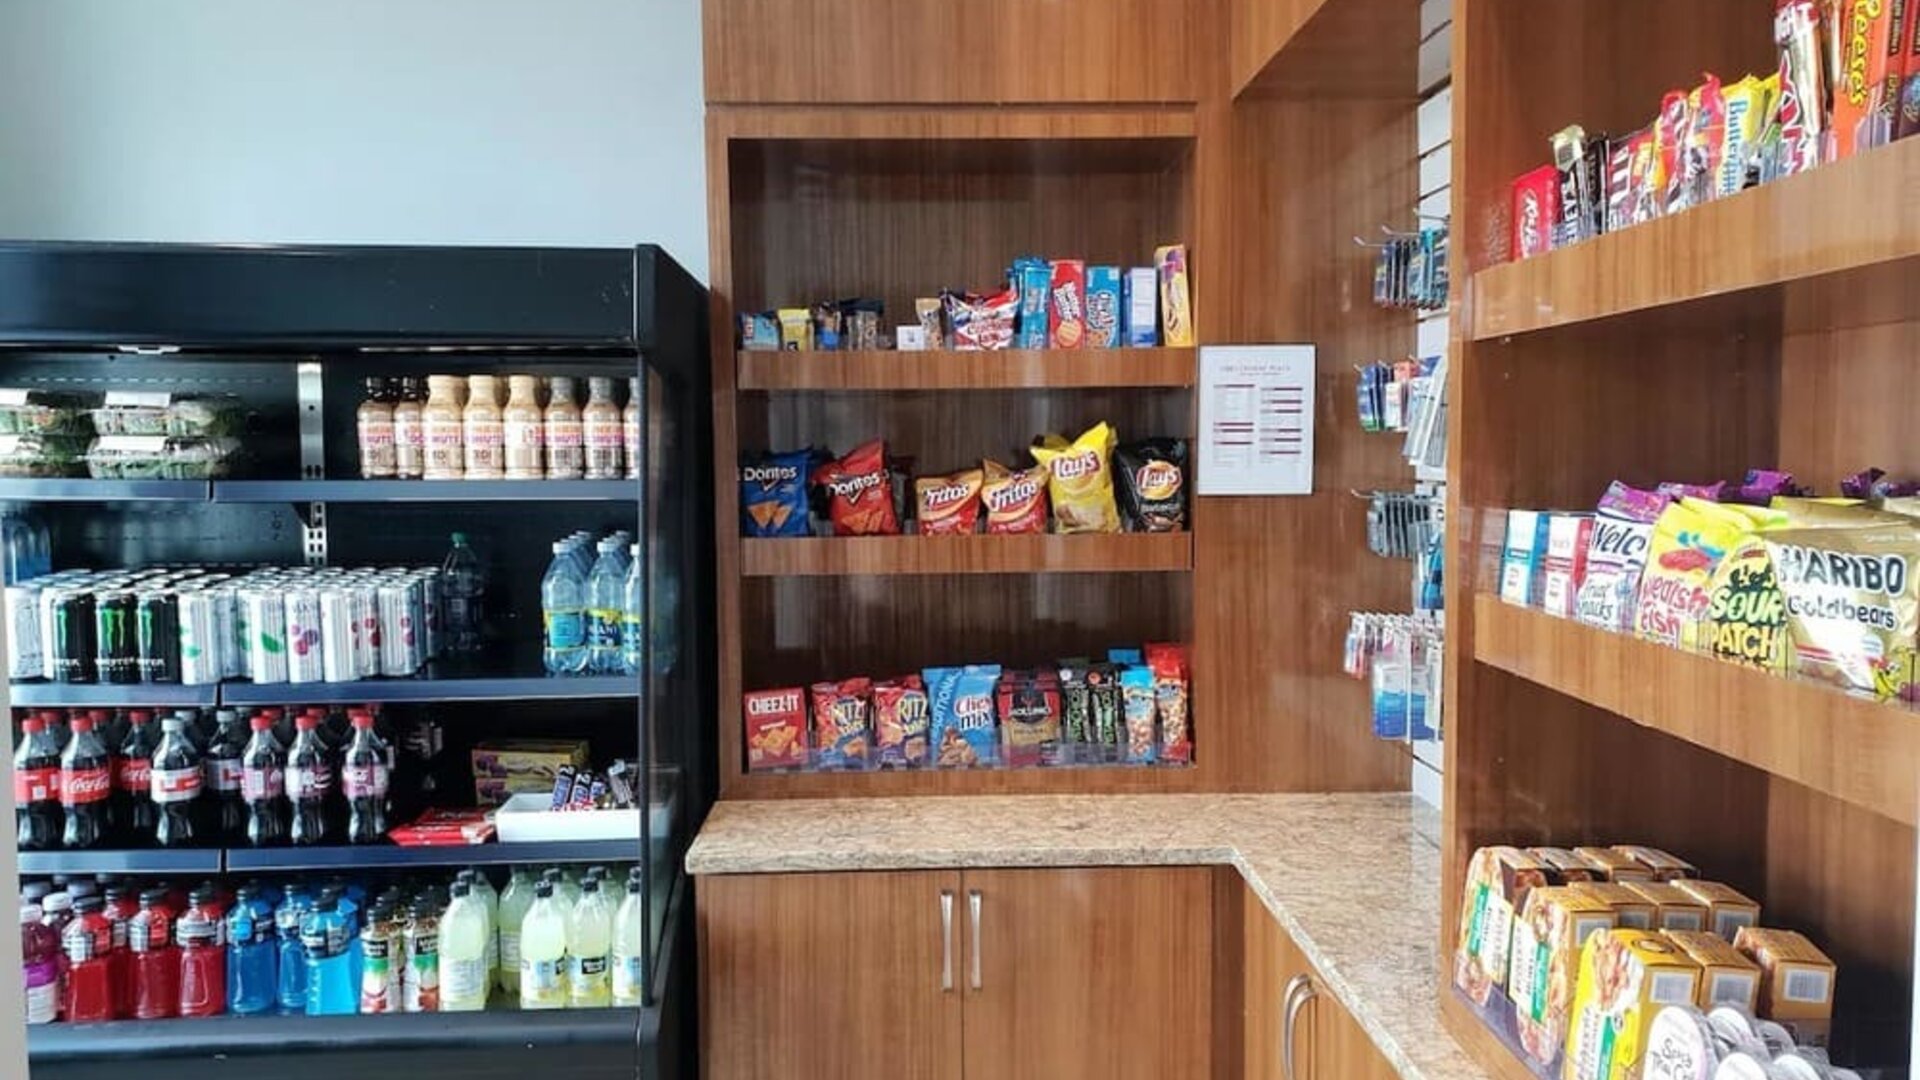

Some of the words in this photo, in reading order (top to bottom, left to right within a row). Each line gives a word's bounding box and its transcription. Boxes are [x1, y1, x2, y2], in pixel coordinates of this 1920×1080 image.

[743, 465, 798, 482] Doritos
[922, 482, 970, 510] Fritos
[987, 481, 1038, 513] Fritos
[1778, 545, 1906, 597] HARIBO
[1786, 594, 1898, 631] Goldbears
[896, 698, 928, 720] RITZ
